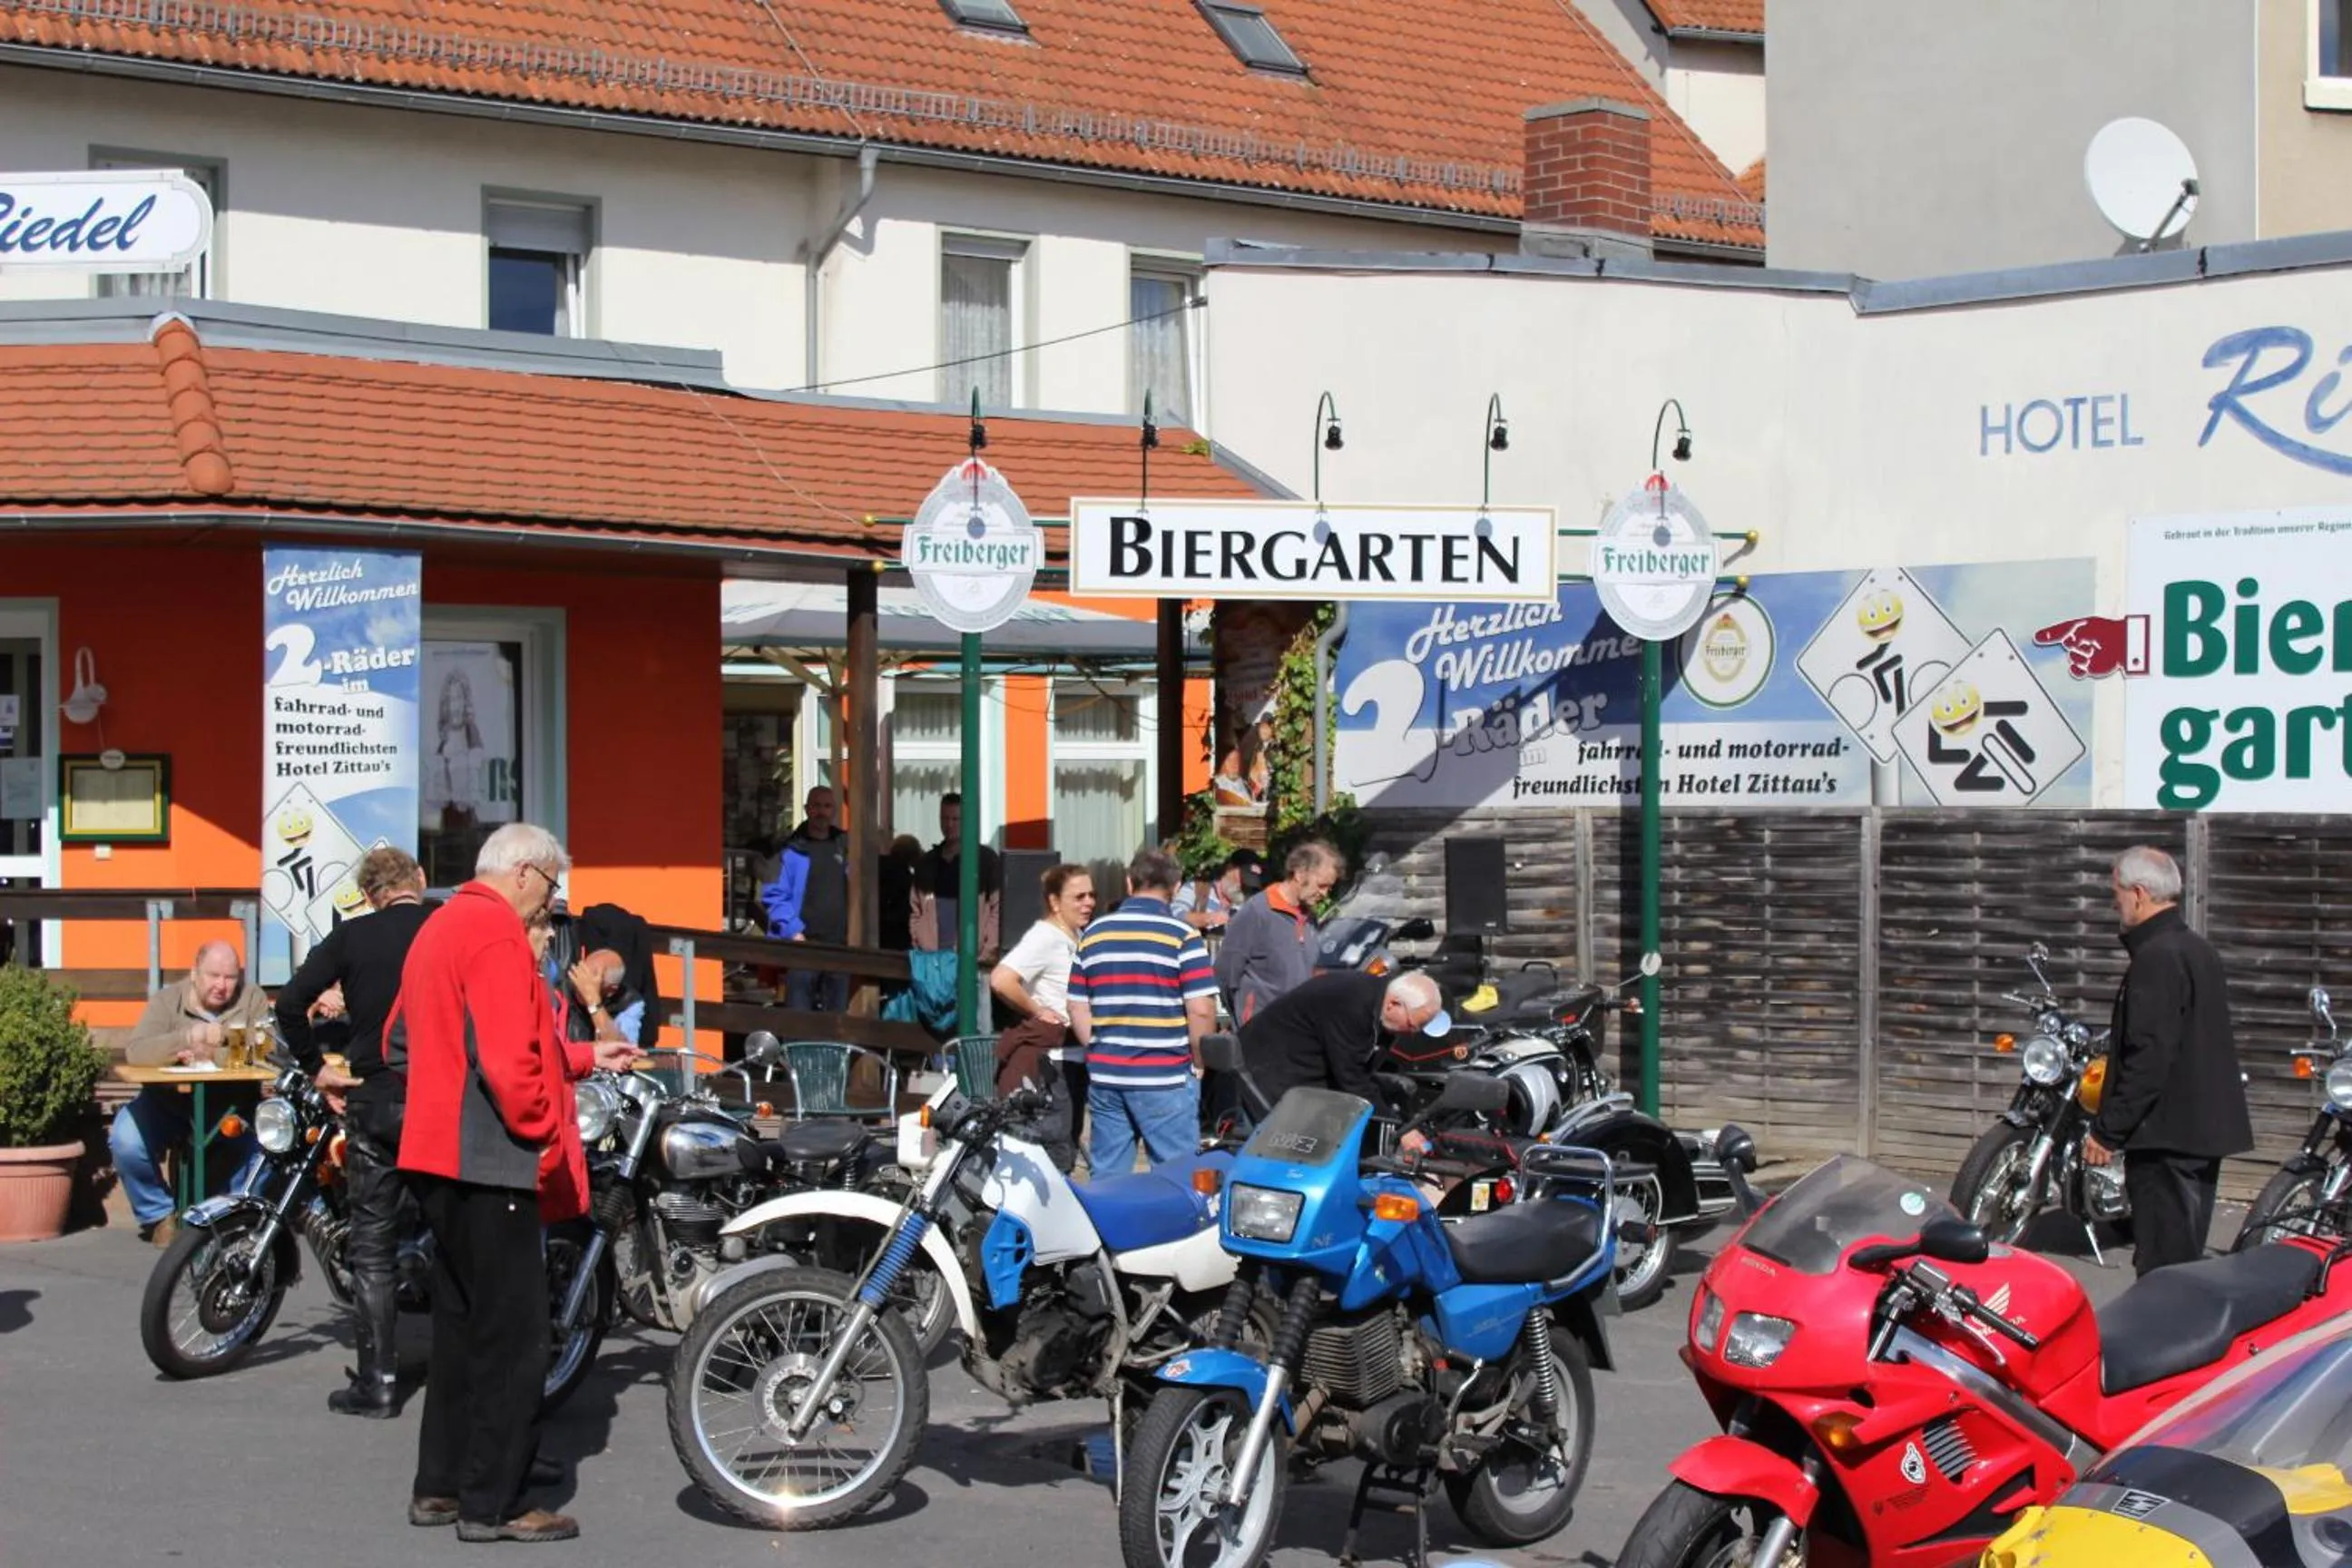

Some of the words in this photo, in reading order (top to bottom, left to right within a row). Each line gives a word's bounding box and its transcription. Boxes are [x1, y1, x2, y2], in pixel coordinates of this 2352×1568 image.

[1979, 393, 2144, 456] HOTEL
[917, 534, 1030, 570] Freiberger
[1109, 516, 1520, 583] BIERGARTEN
[1602, 546, 1710, 579] Freiberger
[268, 559, 363, 595] Herzlich
[286, 582, 418, 612] Willkommen
[1406, 603, 1563, 663] Herzlich
[1435, 634, 1642, 691] Willkomme
[341, 678, 369, 693] im
[357, 706, 384, 719] und
[275, 740, 397, 755] freundlichsten
[1577, 739, 1671, 764] fahrr-
[1678, 739, 1721, 760] und
[276, 761, 328, 777] Hotel
[333, 760, 391, 775] Zittau's
[1513, 774, 1670, 799] freundlichstn
[1677, 772, 1740, 795] Hotel
[1748, 770, 1837, 795] Zittau's
